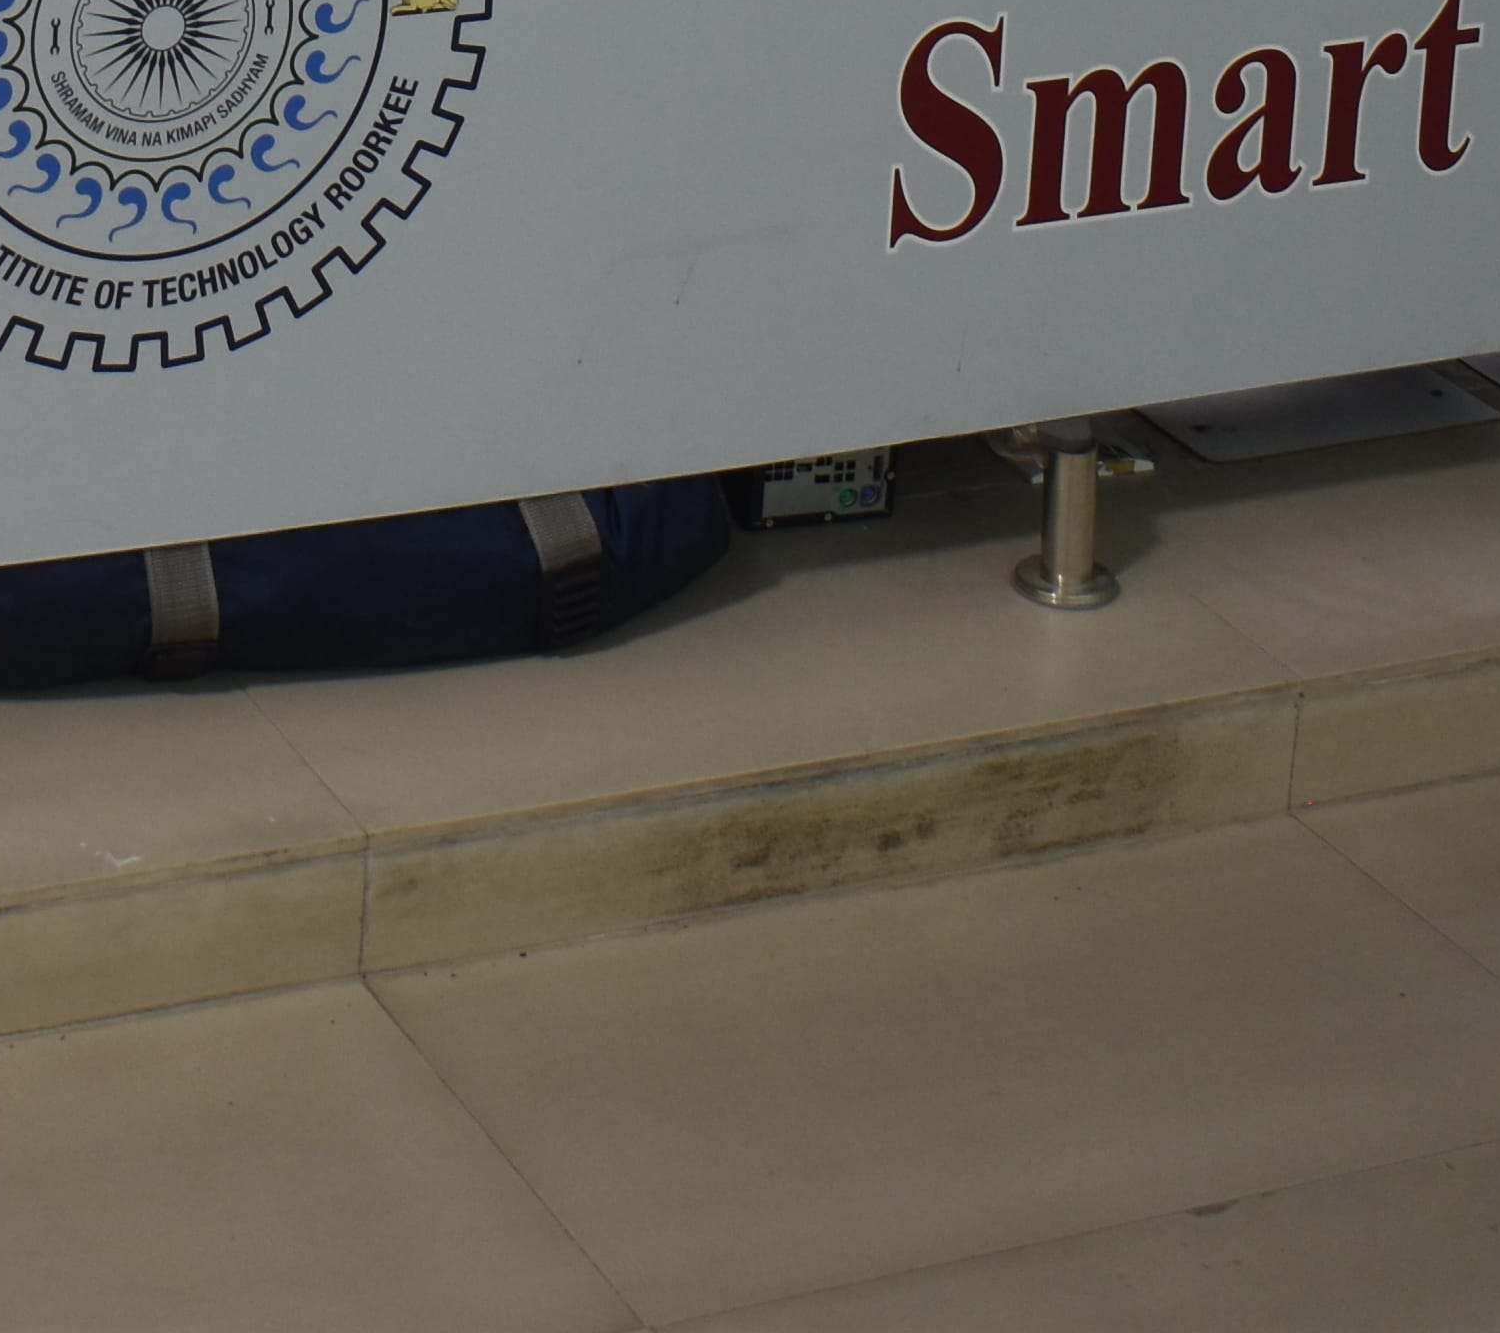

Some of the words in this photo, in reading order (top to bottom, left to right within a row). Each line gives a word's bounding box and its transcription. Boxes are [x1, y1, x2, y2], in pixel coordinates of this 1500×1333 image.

[51, 71, 106, 133] SHRAMAM
[105, 123, 137, 146] VINA
[142, 131, 162, 147] NA
[166, 114, 218, 145] KIMAPI
[217, 53, 269, 119] SADHYAM
[93, 279, 134, 310] OF
[143, 203, 327, 309] TECHNOLOGY
[323, 75, 419, 212] ROORKEE
